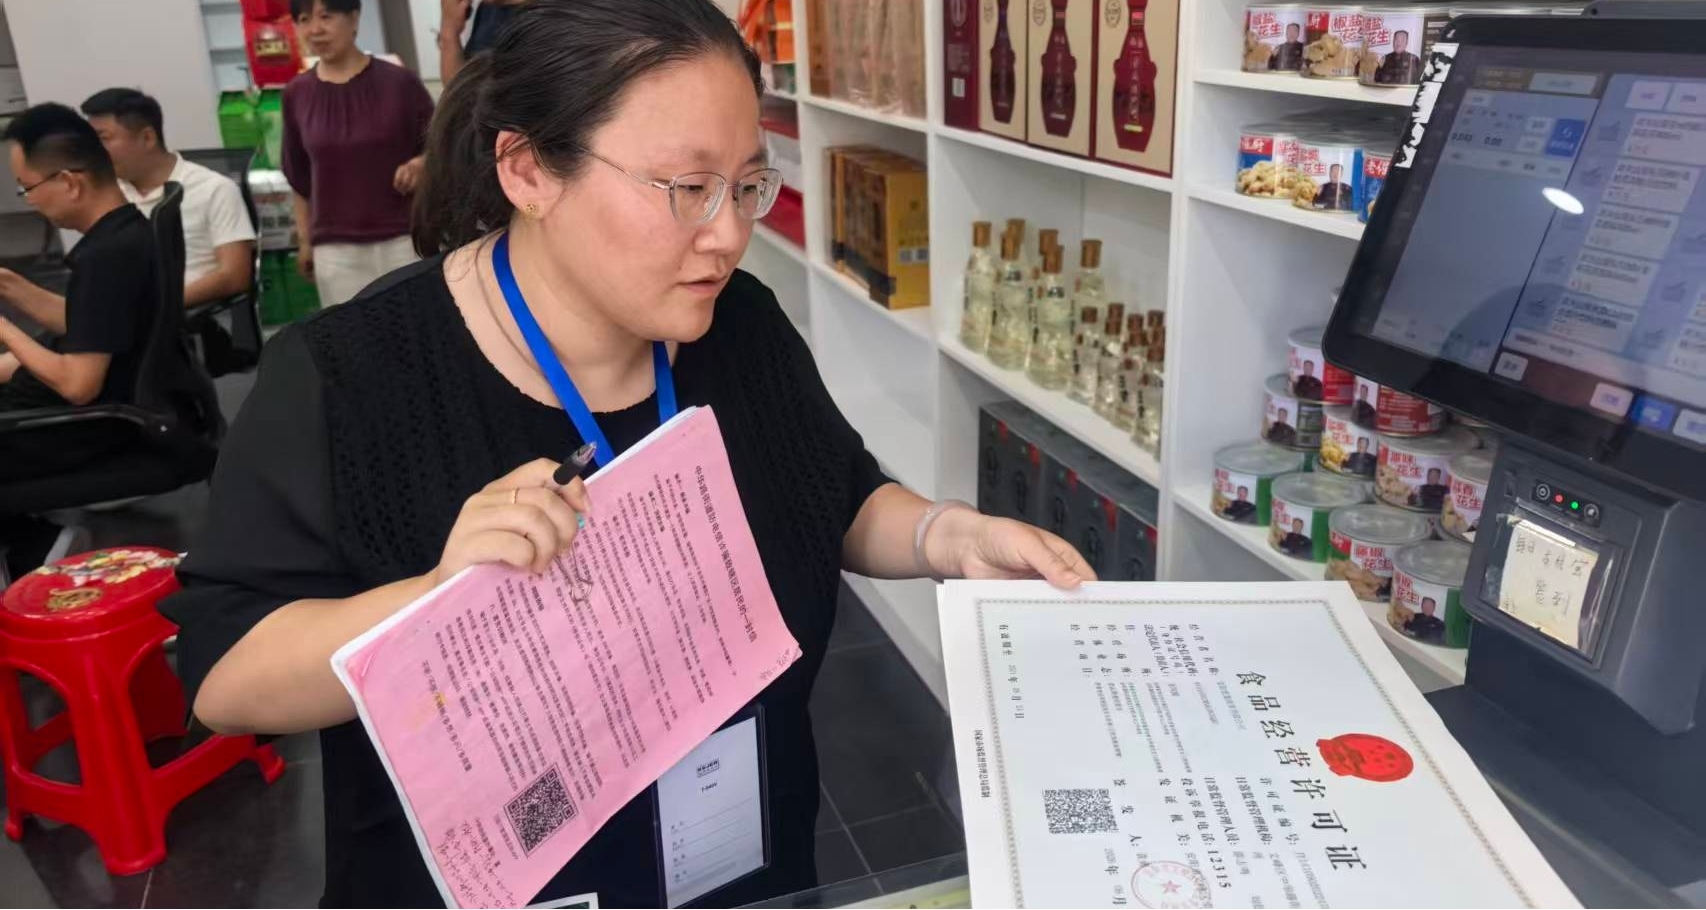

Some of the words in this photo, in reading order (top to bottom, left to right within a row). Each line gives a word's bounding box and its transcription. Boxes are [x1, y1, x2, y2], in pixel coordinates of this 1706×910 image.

[1234, 670, 1369, 871] 食品经营许可证
[1208, 849, 1232, 888] 12315
